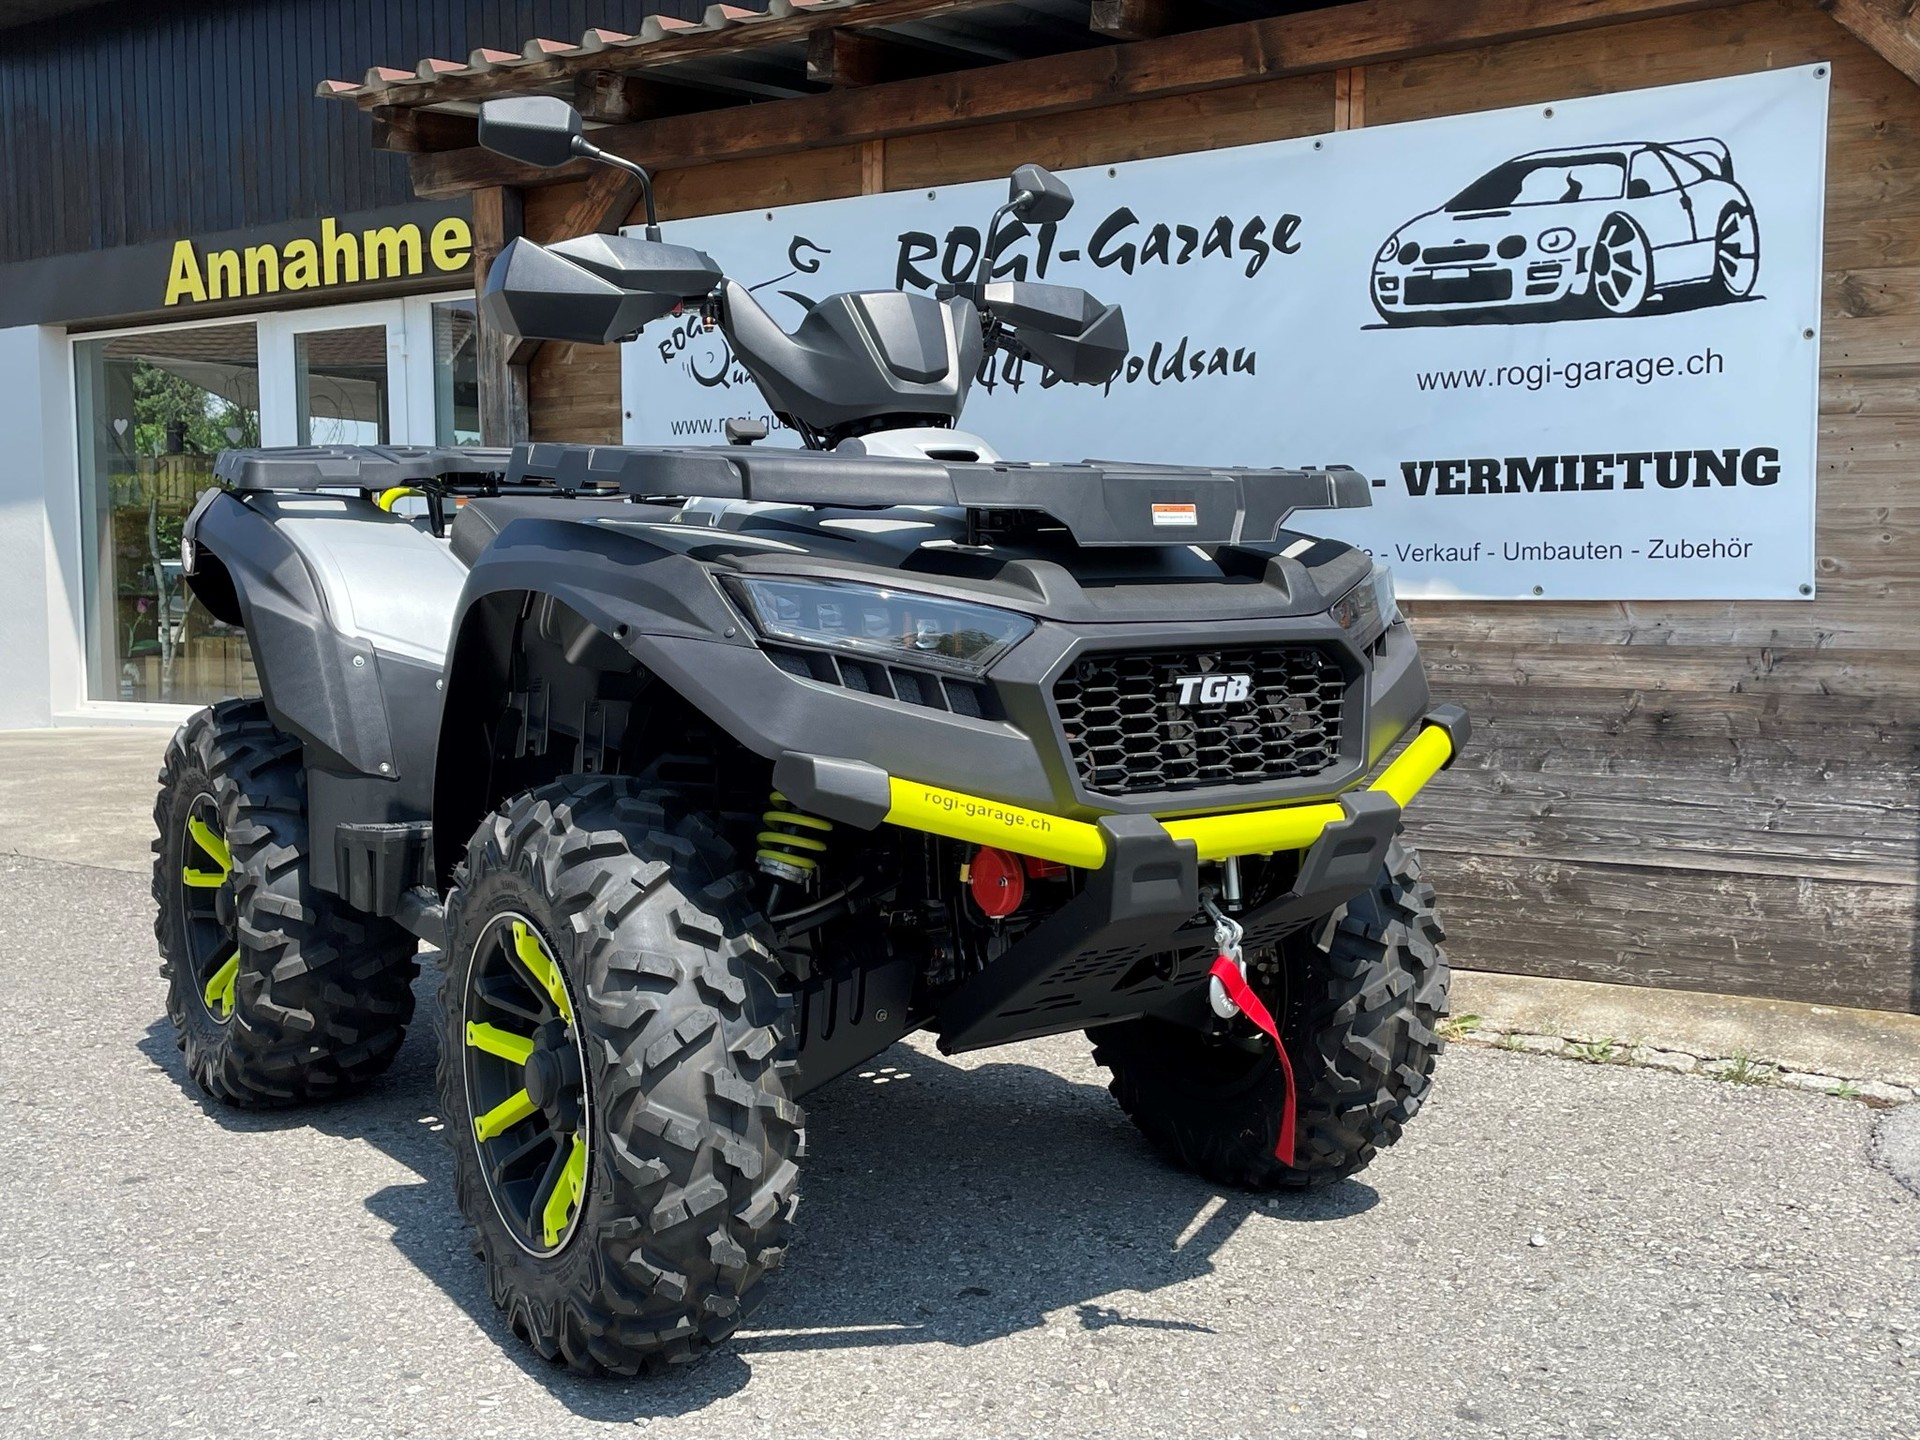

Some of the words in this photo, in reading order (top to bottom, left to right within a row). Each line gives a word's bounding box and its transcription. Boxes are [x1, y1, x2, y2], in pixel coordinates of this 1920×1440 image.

[164, 217, 472, 306] Annahme
[896, 206, 1302, 291] ROGI-Garage
[658, 315, 704, 364] ROG
[1416, 347, 1724, 391] www.rogi-garage.ch
[1400, 446, 1781, 496] VERMIETUNG
[1395, 542, 1482, 562] Verkauf
[1503, 541, 1622, 561] Umbauten
[1647, 538, 1753, 559] Zubehör
[1176, 674, 1251, 705] TGB
[924, 791, 1051, 832] rogi-garage.ch
